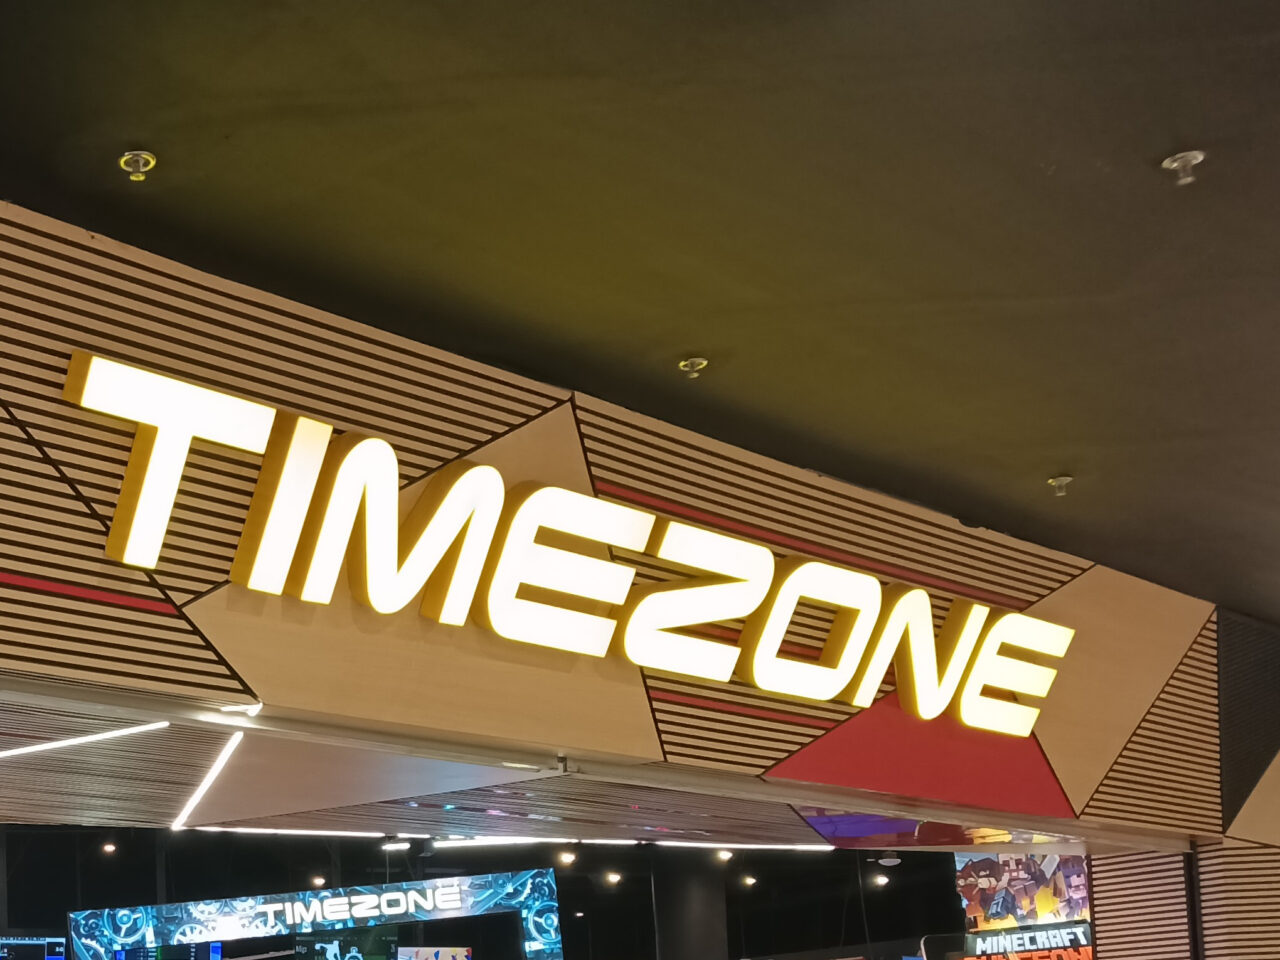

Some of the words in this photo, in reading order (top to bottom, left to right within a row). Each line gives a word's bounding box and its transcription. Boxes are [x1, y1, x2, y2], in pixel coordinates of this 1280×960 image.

[66, 351, 1076, 738] TIMEZONE
[257, 886, 462, 926] TIMEZONE
[976, 927, 1087, 955] MINECRAFT
